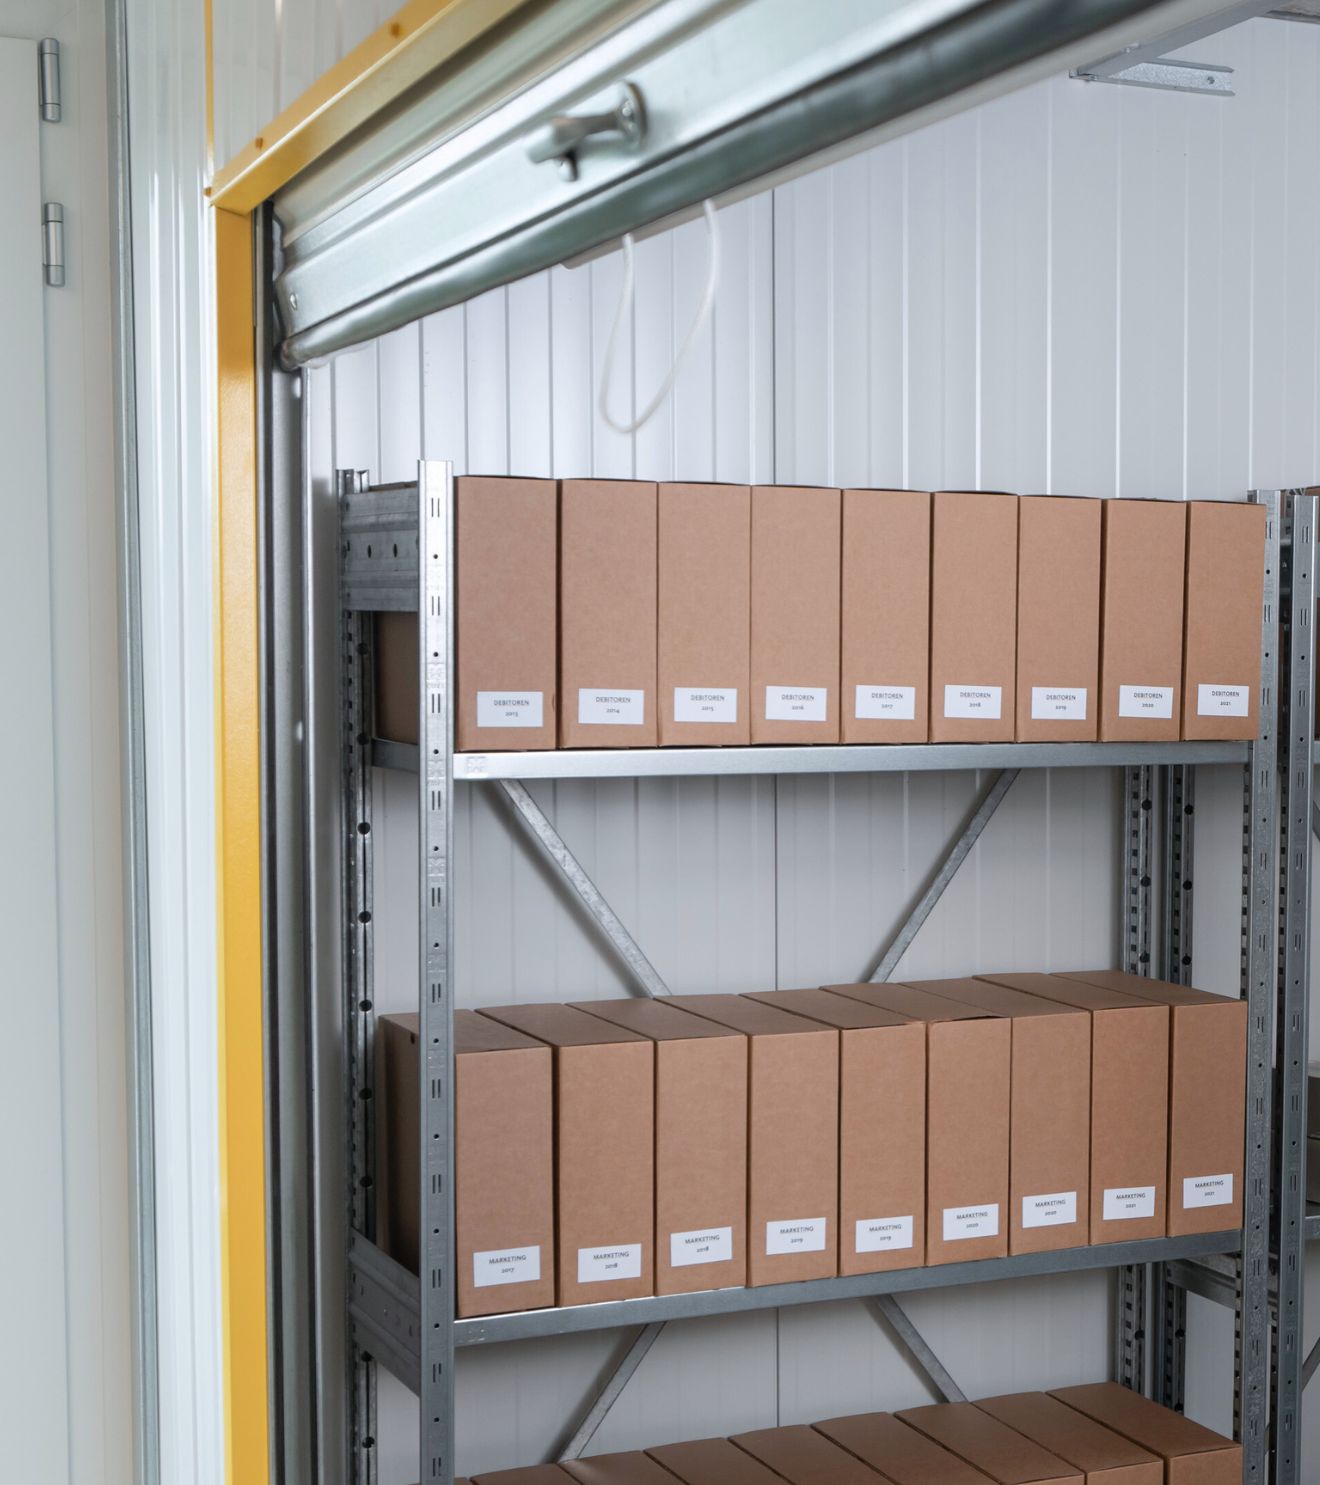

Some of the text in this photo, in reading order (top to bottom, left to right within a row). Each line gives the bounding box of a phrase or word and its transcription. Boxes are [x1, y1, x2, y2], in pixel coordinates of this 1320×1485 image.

[690, 694, 725, 702] DEBITOREN
[871, 692, 904, 700] DEBITOREN
[493, 699, 530, 707] DEBITOREN
[1194, 1179, 1225, 1189] MARKETING
[1115, 1192, 1146, 1200] MARKETING
[1034, 1199, 1066, 1208] MARKETING
[956, 1211, 988, 1220] MARKETING
[779, 1225, 814, 1234] MARKETING
[868, 1223, 902, 1233] MARKETING
[684, 1234, 720, 1245] MARKETING
[488, 1254, 527, 1265] MARKETING
[592, 1251, 630, 1260] MARKETING
